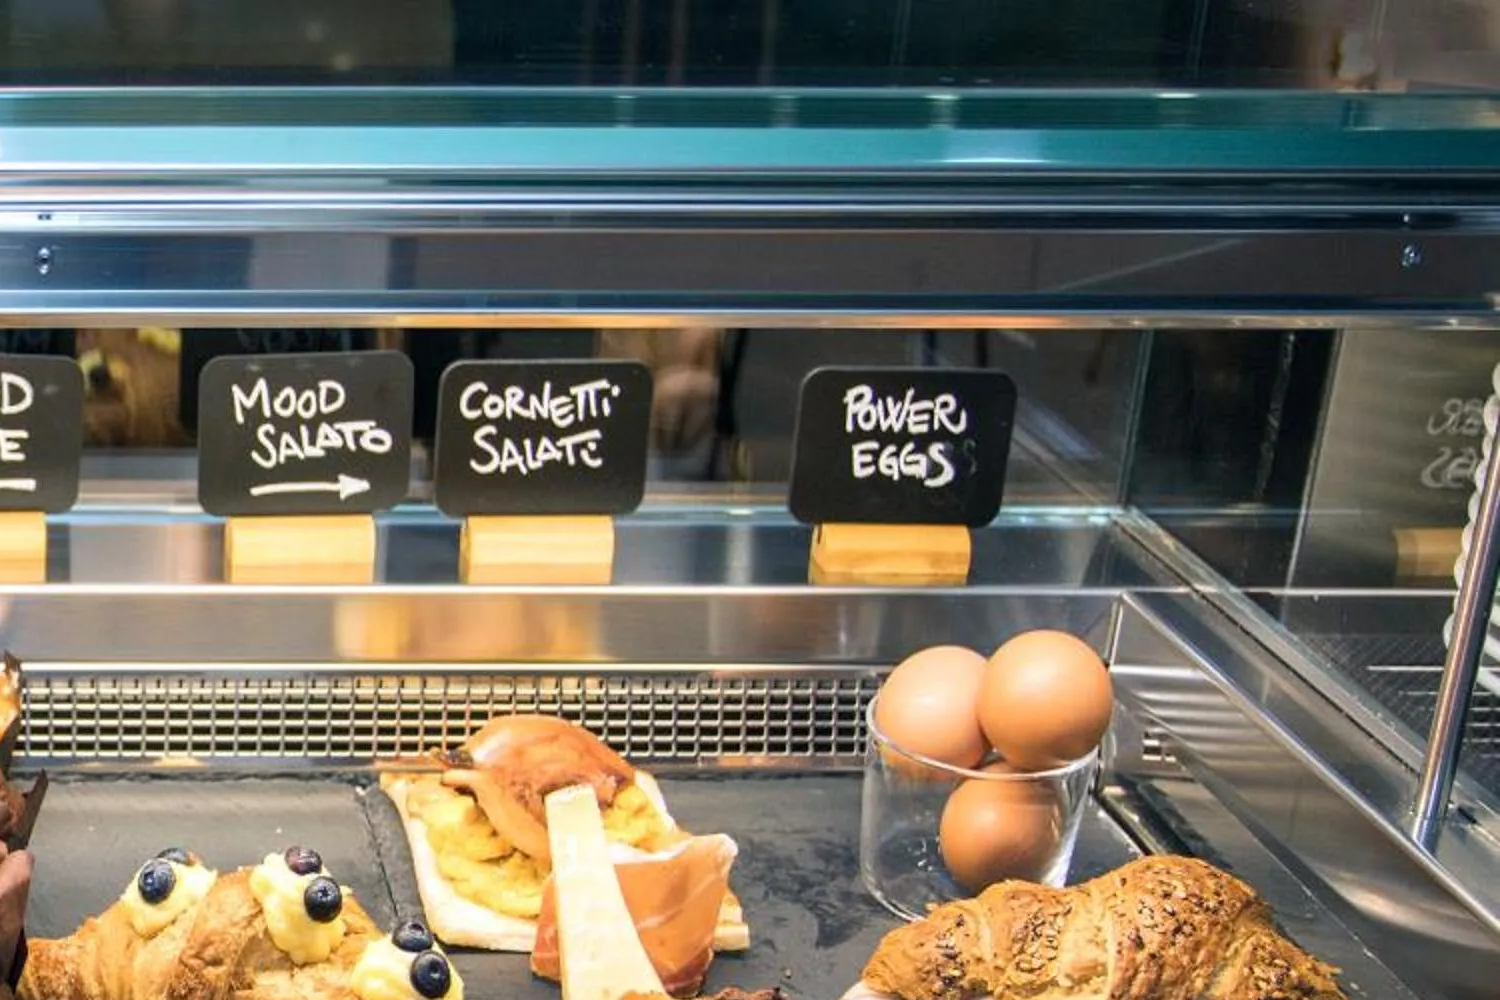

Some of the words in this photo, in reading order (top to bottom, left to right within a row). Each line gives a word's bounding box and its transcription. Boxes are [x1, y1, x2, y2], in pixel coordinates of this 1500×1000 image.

[231, 377, 345, 425] MOOD
[843, 384, 967, 434] POWER
[250, 420, 393, 468] SALATO
[851, 440, 955, 488] EGGS
